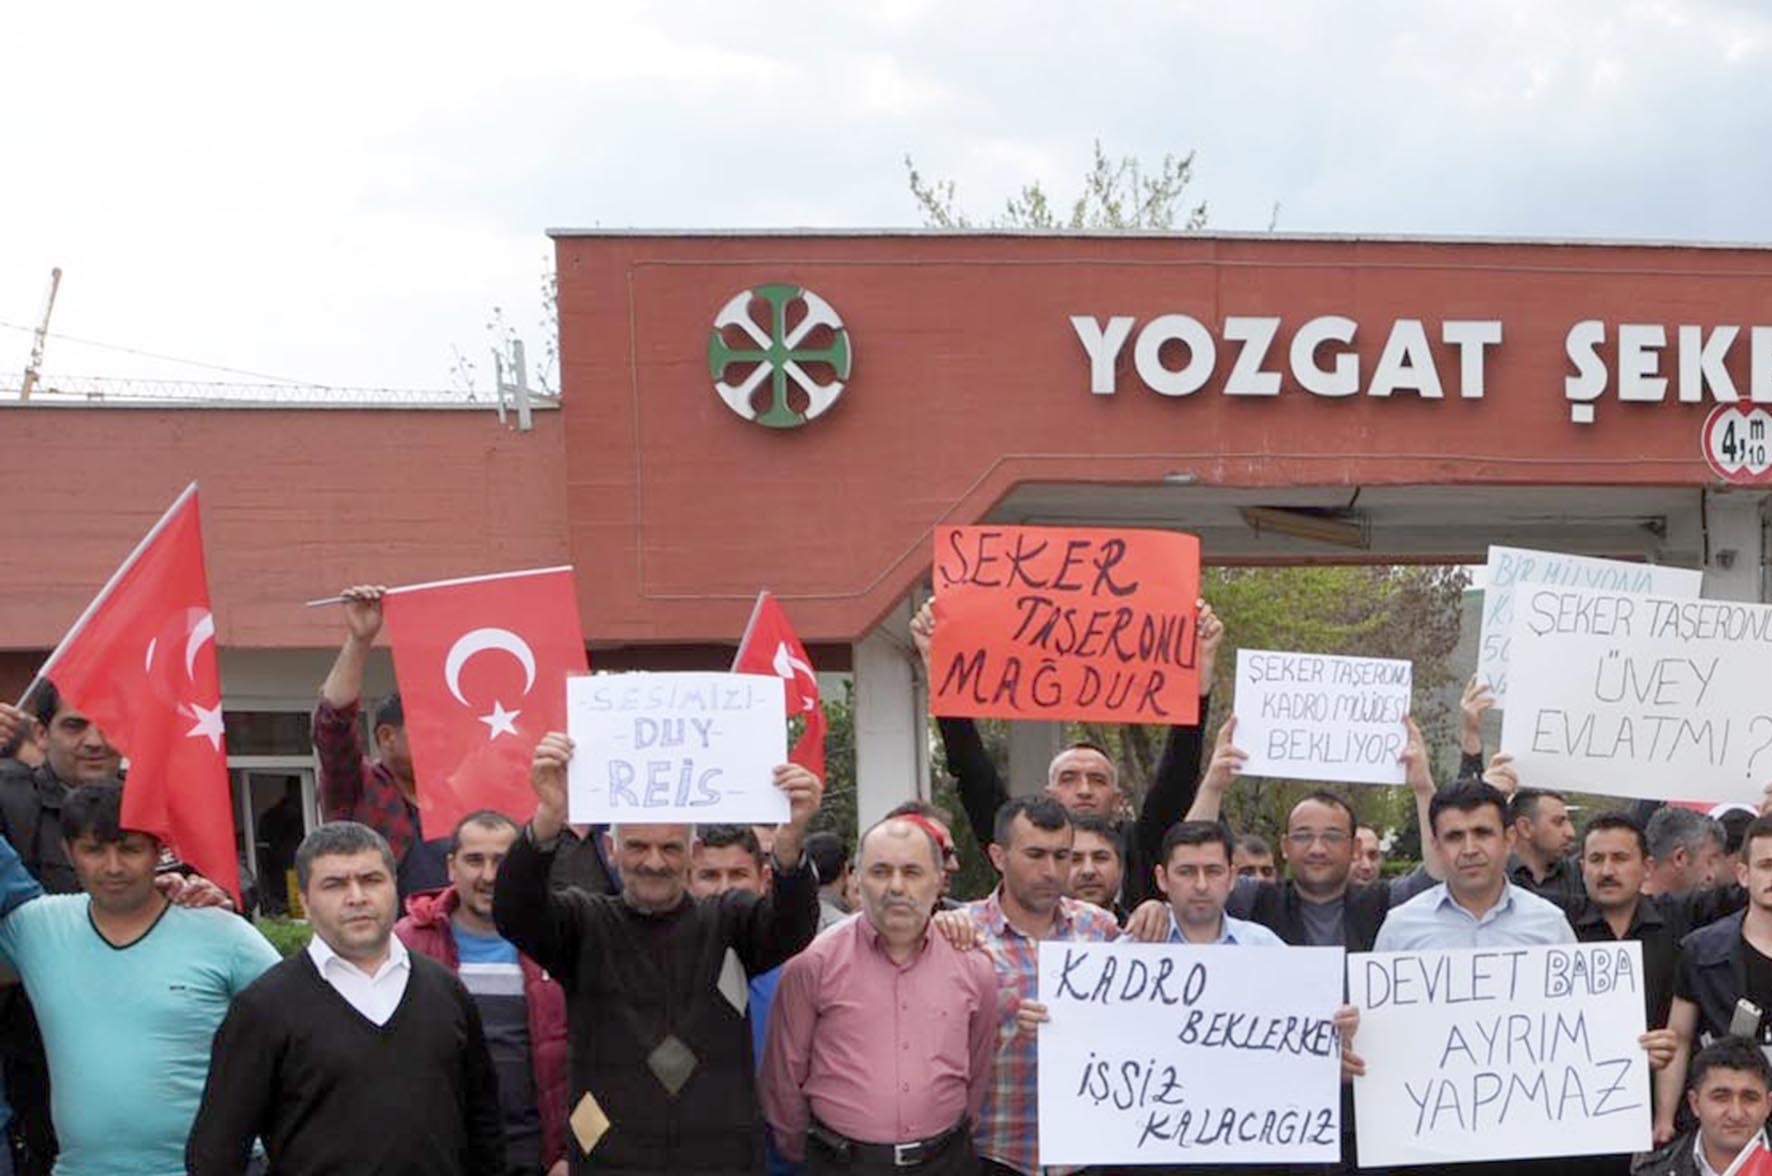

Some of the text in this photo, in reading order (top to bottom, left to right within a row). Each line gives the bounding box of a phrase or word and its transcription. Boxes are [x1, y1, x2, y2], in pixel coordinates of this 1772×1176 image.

[1069, 313, 1502, 398] YOZGAT
[1527, 590, 1634, 637] ŞEKER
[1248, 654, 1325, 684] ŞEKER
[1595, 650, 1720, 706] ÜVEY
[634, 716, 714, 750] DUY
[1261, 691, 1329, 723] KADRO
[1055, 949, 1207, 1007] KADRO
[1366, 948, 1636, 1010] DEVLET BABA
[1439, 1009, 1592, 1070] AYRIM
[1403, 1059, 1643, 1137] YAPMAZ
